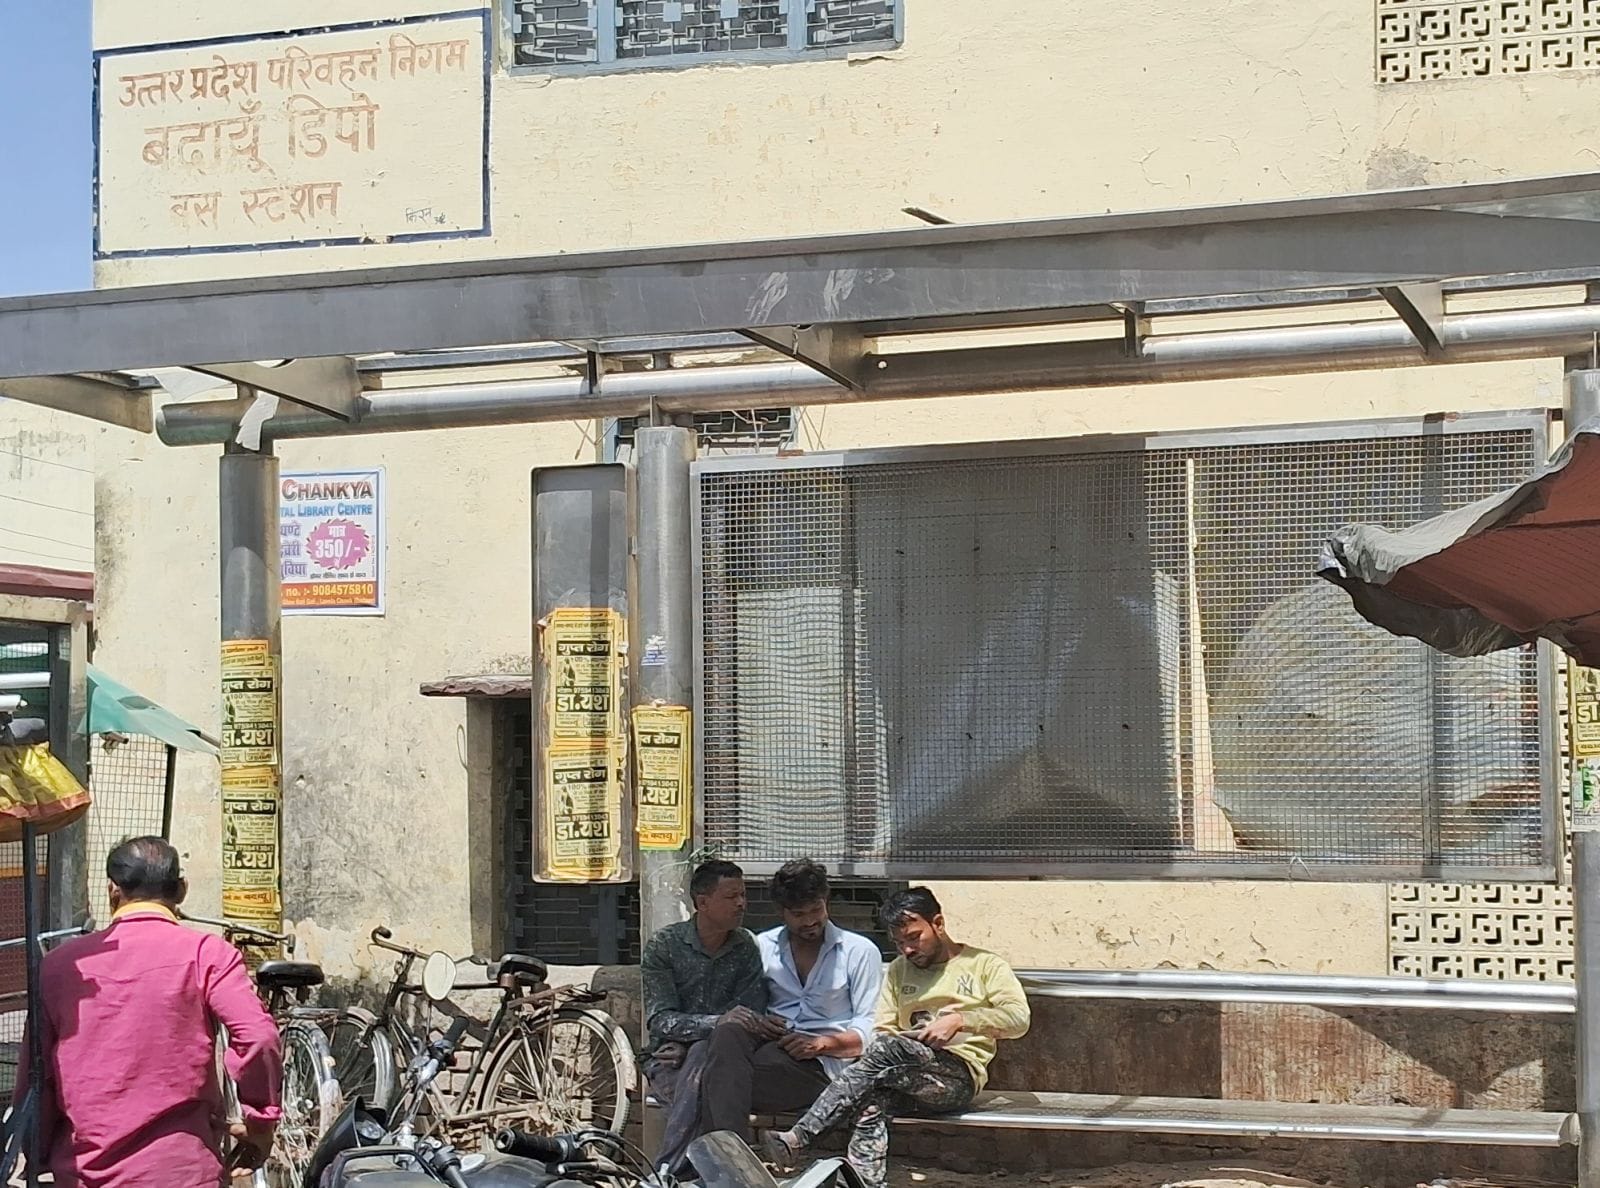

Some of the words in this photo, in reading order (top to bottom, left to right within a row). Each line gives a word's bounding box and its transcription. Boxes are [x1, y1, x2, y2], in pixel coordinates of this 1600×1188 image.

[118, 69, 185, 107] उत्तर
[189, 54, 259, 102] प्रदेश
[267, 45, 382, 93] परिवहन
[388, 32, 469, 80] निगम
[286, 92, 380, 159] डिपो
[281, 479, 374, 500] CHANKYA
[297, 504, 335, 517] LIBRARY
[337, 502, 373, 516] CENTRE
[315, 539, 361, 559] 350/-
[312, 583, 374, 596] 9084575810
[558, 643, 584, 656] गुप्त
[586, 640, 609, 652] रोग
[247, 678, 271, 690] रोग
[653, 733, 679, 745] रोग
[555, 770, 581, 784] गुप्त
[583, 767, 606, 780] रोग
[251, 800, 274, 812] रोग
